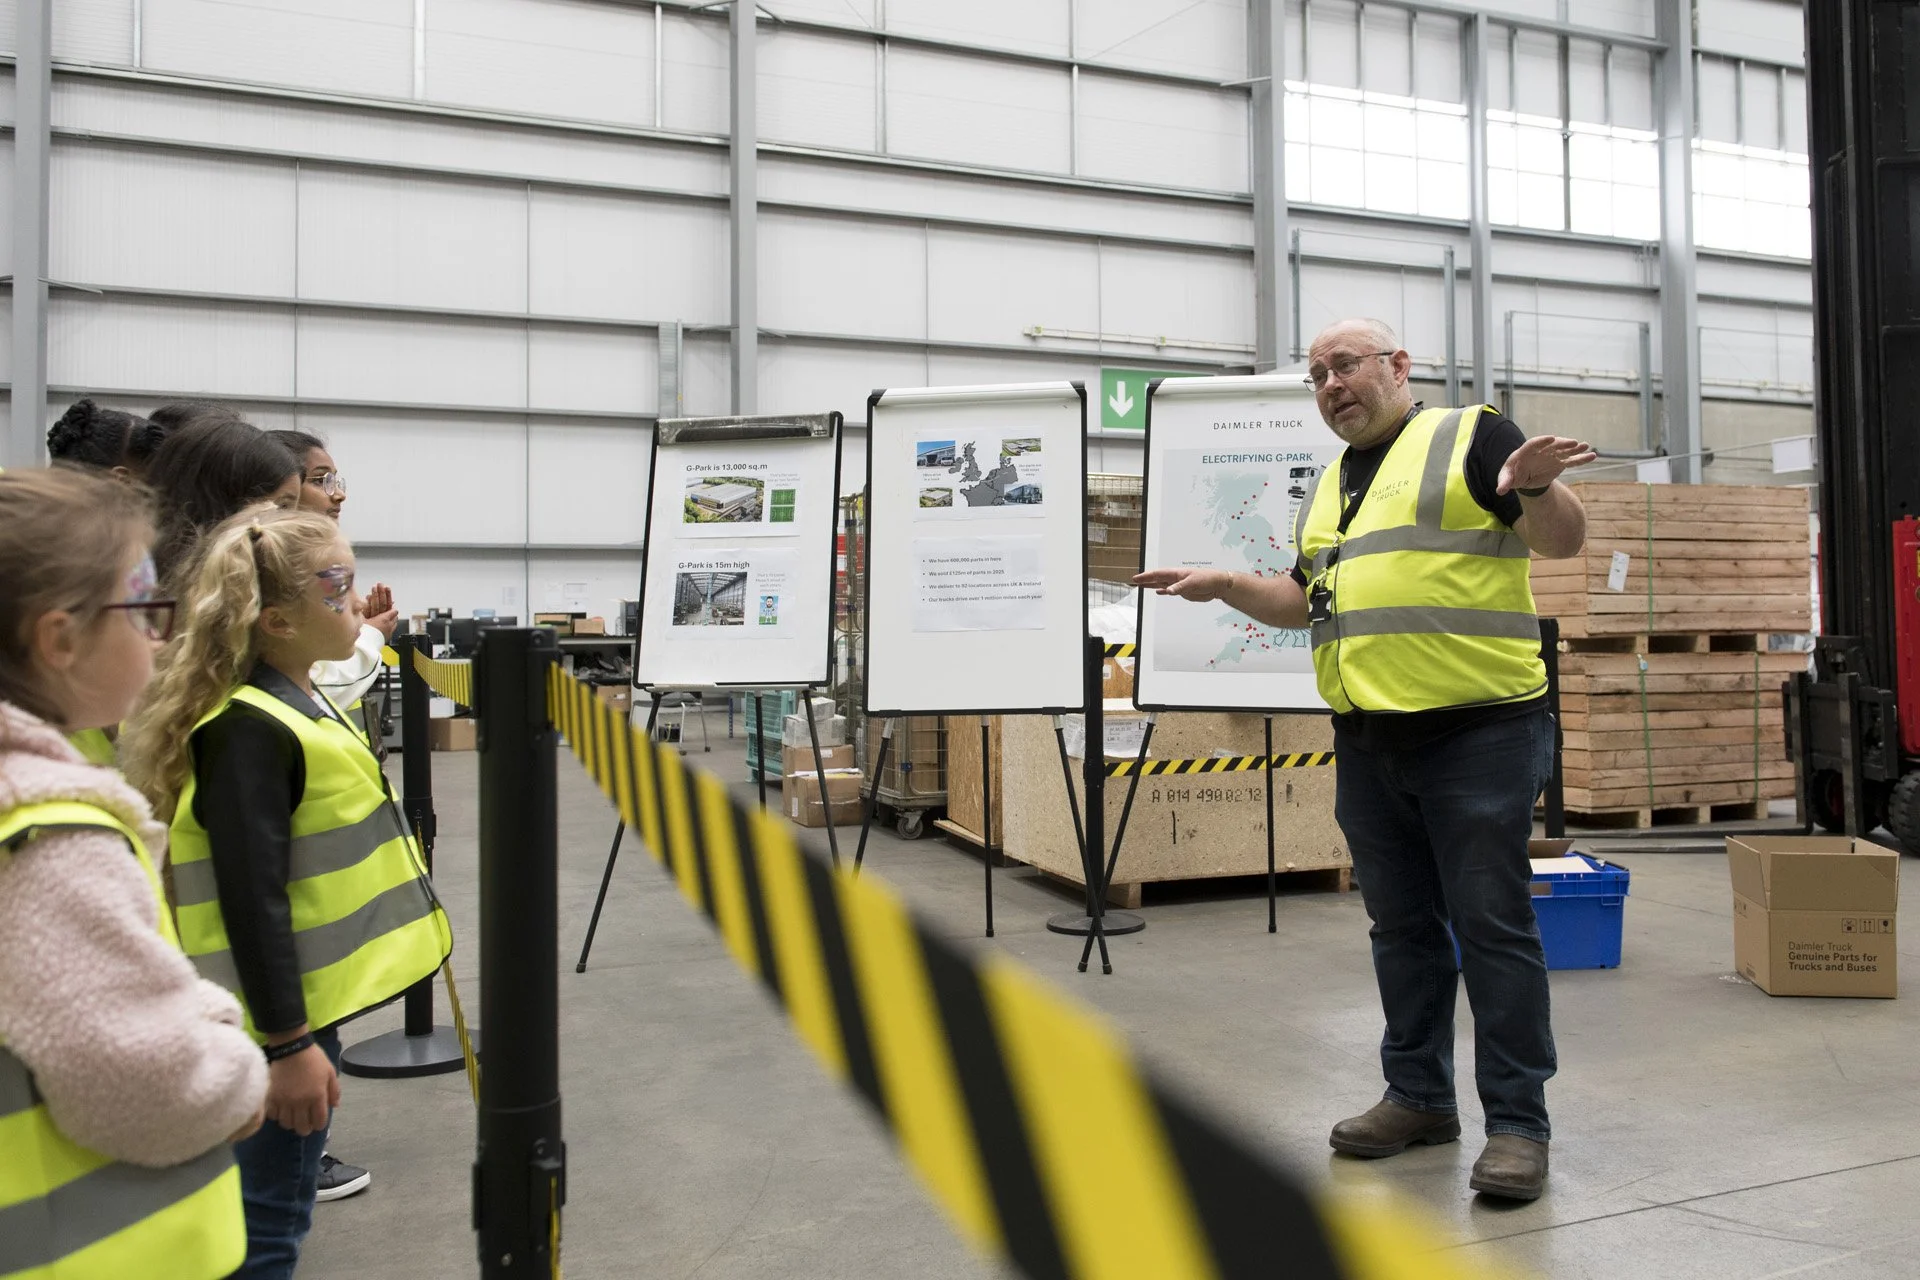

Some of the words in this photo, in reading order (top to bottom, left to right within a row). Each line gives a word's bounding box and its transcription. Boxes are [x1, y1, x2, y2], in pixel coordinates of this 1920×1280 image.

[1213, 421, 1262, 430] DAIMLER
[1269, 420, 1303, 428] TRUCK
[1202, 453, 1273, 464] ELECTRIFYING
[1275, 452, 1313, 462] G-PARK
[686, 464, 712, 472] G-Park
[1371, 480, 1410, 498] DAIMLER
[1376, 489, 1401, 502] TRUCK
[733, 561, 750, 570] high
[1152, 789, 1160, 803] A
[1788, 942, 1824, 951] Daimler
[1826, 942, 1853, 951] Truck
[1788, 952, 1830, 961] Genuine
[1833, 952, 1860, 962] Parts
[1863, 953, 1878, 962] for
[1788, 962, 1822, 970] Trucks
[1825, 963, 1844, 971] and
[1847, 963, 1877, 972] Buses
